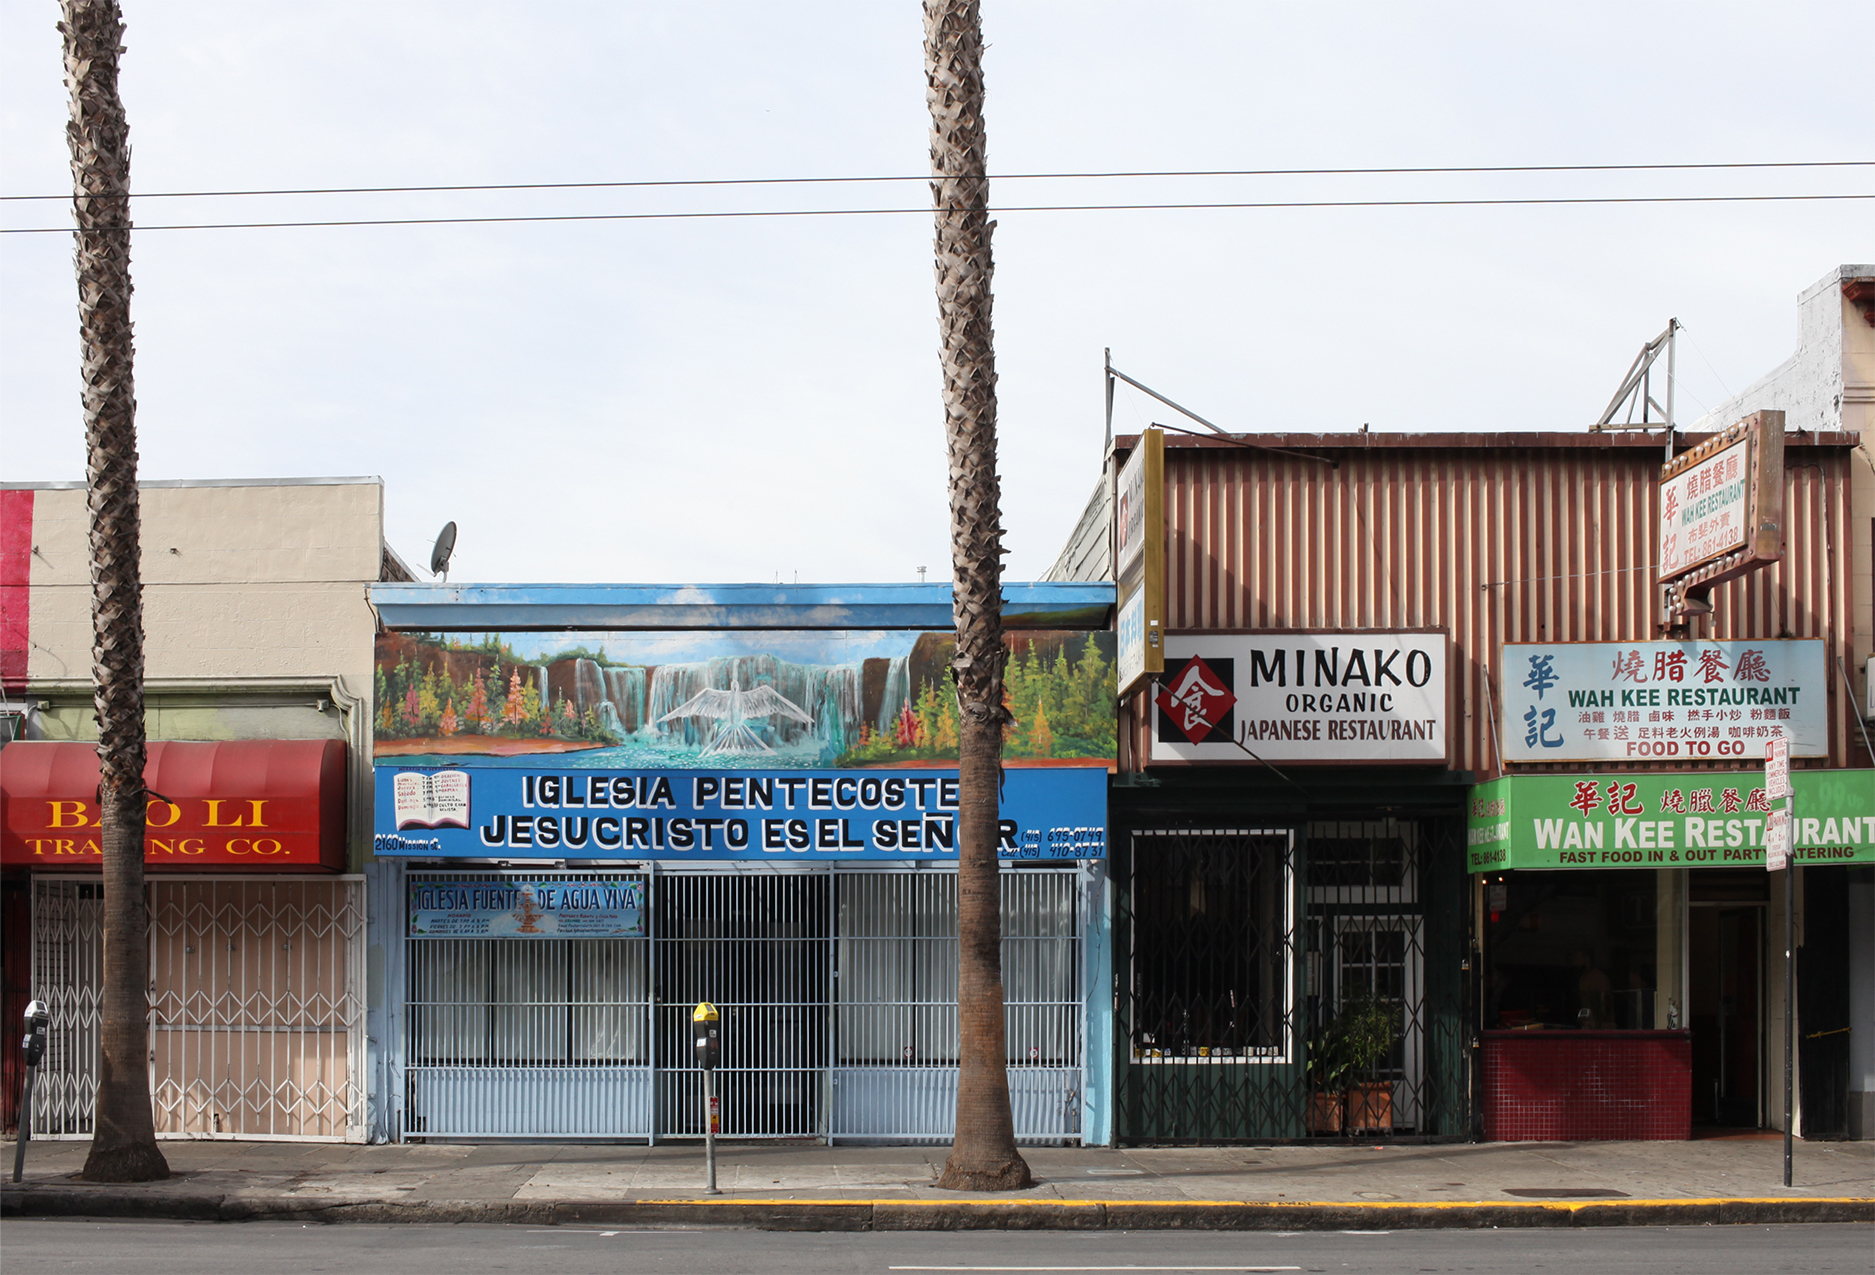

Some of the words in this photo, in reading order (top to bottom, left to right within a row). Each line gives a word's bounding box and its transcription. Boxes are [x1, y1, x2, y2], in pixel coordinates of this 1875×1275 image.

[1681, 507, 1695, 527] WAH
[1695, 498, 1706, 521] KEE
[1707, 479, 1745, 514] RESTAURANT
[1684, 546, 1700, 565] TEL:
[1702, 526, 1738, 557] 861-4138
[1250, 647, 1432, 688] MINAKO
[1286, 692, 1394, 713] ORGANIC
[1523, 654, 1565, 749] 華記
[1568, 690, 1614, 707] WAH
[1621, 689, 1660, 706] KEE
[1667, 687, 1801, 706] RESTAURANT
[1241, 719, 1321, 744] JAPANESE
[1328, 719, 1436, 741] RESTAURANT
[1627, 741, 1679, 756] FOOD
[1685, 741, 1711, 756] TO
[1717, 740, 1745, 755] GO
[522, 776, 676, 810] IGLESIA
[693, 776, 961, 811] PENTECOSTE
[1569, 780, 1644, 819] 華記
[46, 800, 181, 828] BO
[201, 799, 269, 827] LI
[375, 834, 399, 851] 2160
[480, 815, 749, 851] JESUCRISTO
[761, 818, 810, 852] ES
[816, 819, 865, 852] EL
[872, 812, 1020, 852] SEÑR
[1021, 829, 1042, 843] (415)
[1047, 827, 1104, 842] 695-0749
[1685, 816, 1875, 848] RESTRANT
[25, 838, 206, 855] TRANG
[226, 838, 291, 855] CO.
[1020, 843, 1041, 858] (415)
[1049, 842, 1105, 857] 410-8731
[1559, 851, 1597, 863] FAST
[1601, 850, 1643, 863] FOOD
[1648, 850, 1664, 862] IN
[1669, 849, 1680, 861] &
[1684, 850, 1717, 862] OUT
[1793, 847, 1854, 859] TERING
[418, 889, 470, 911] IGLESIA
[473, 889, 522, 911] FUENTE
[538, 889, 556, 911] DE
[561, 889, 601, 911] AGUA
[604, 889, 637, 911] VIVA
